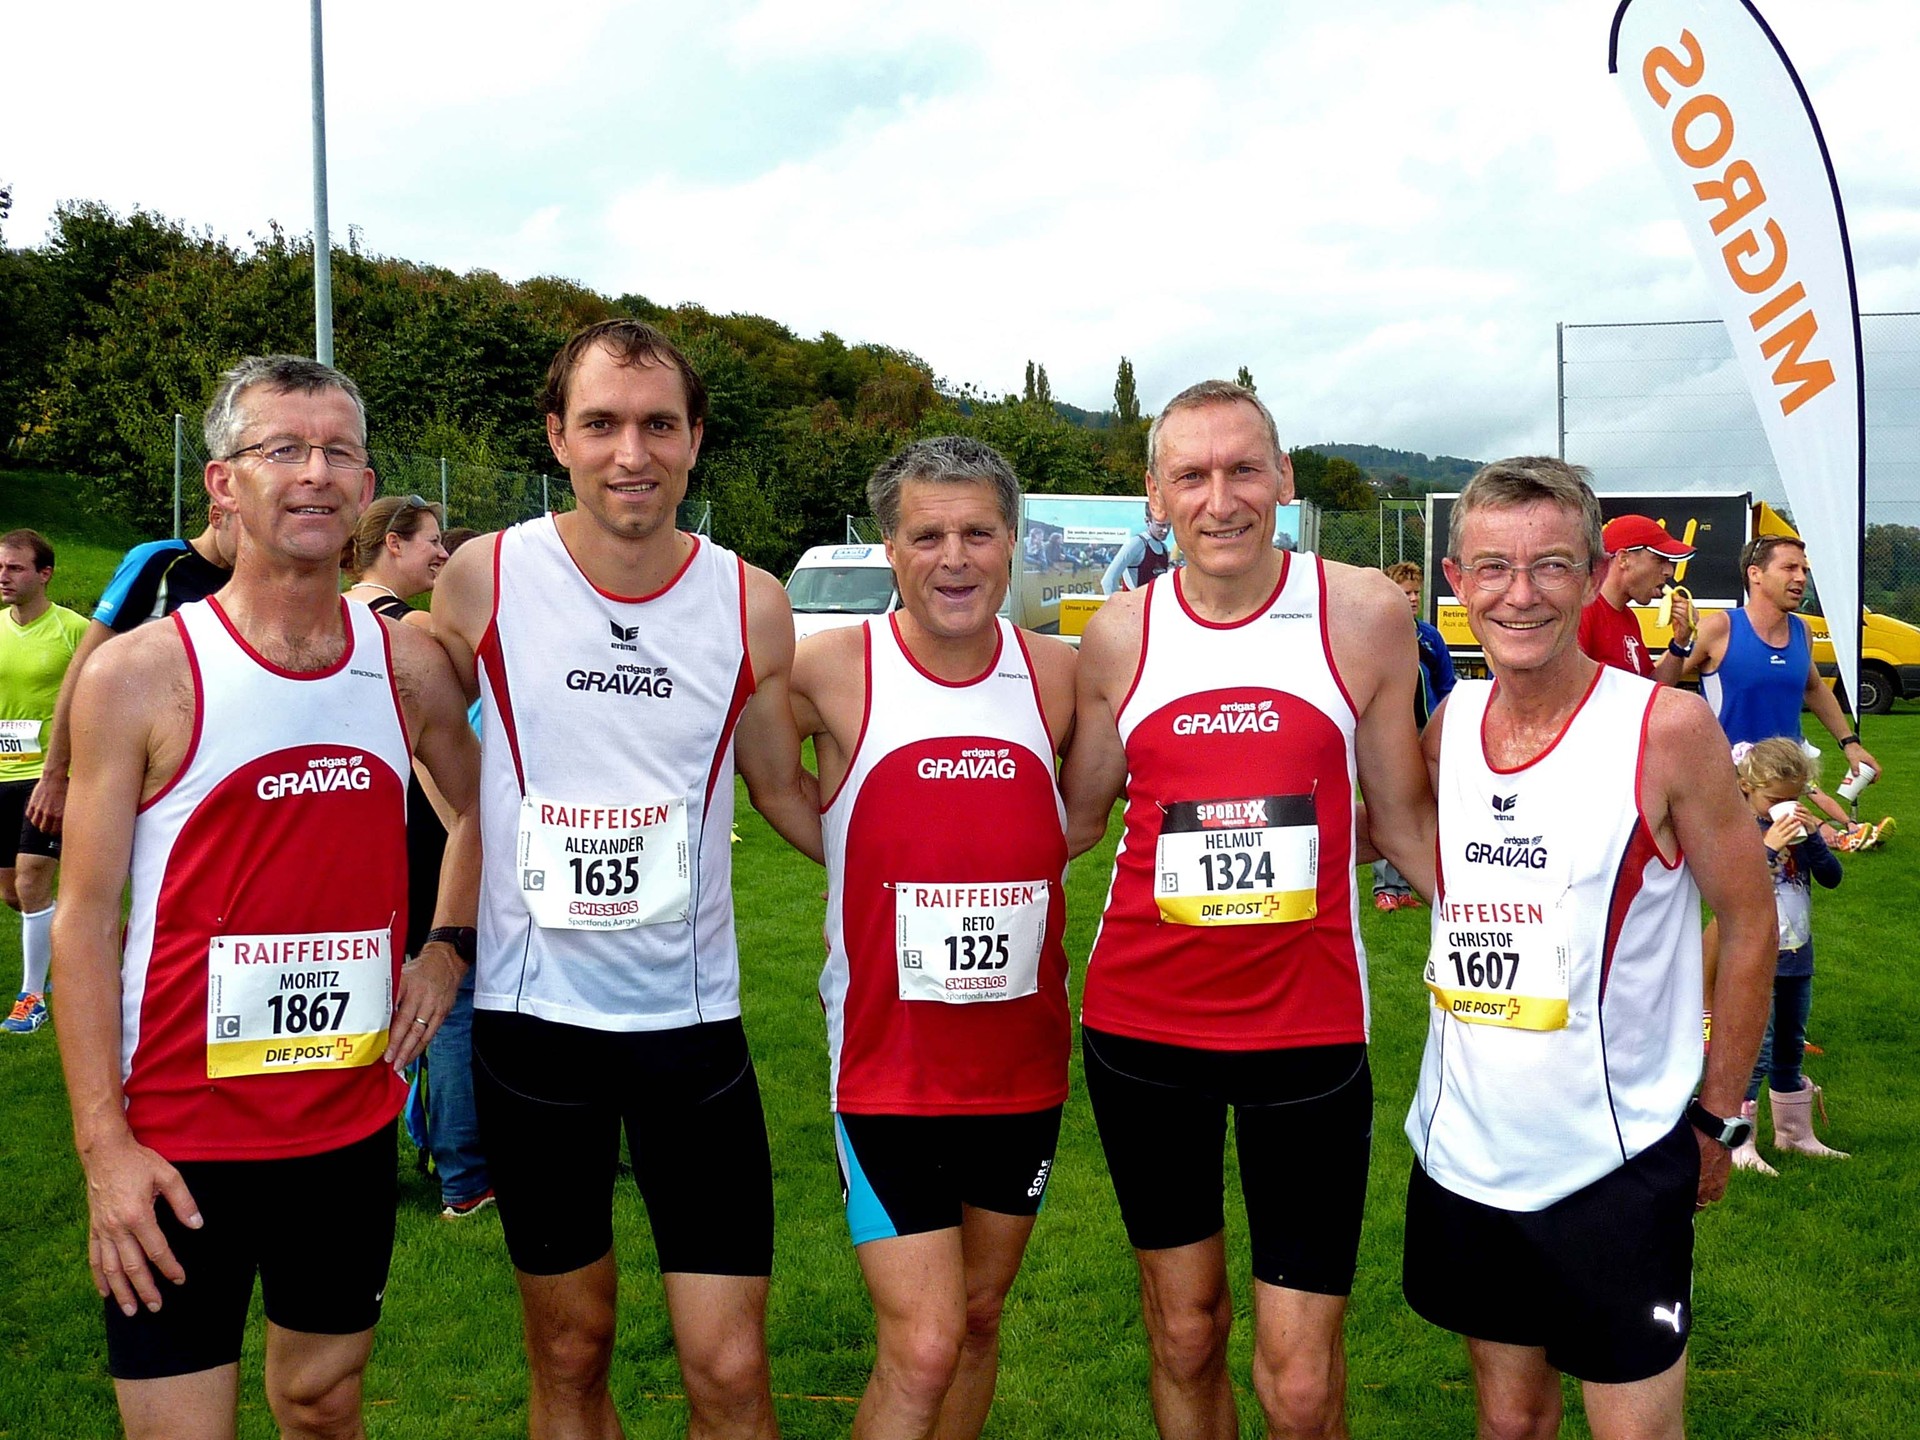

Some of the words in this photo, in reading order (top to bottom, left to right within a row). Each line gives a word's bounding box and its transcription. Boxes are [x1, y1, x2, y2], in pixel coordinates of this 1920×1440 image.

[1042, 585, 1064, 601] DIE
[1068, 581, 1092, 594] POST
[1811, 631, 1831, 639] POS
[611, 642, 637, 652] erima
[350, 669, 384, 680] BROOKS
[616, 664, 652, 674] erdgas
[566, 670, 674, 699] GRAVAG
[1220, 702, 1256, 713] erdgas
[1172, 711, 1280, 735] GRAVAG
[0, 739, 22, 752] 1501
[962, 748, 996, 758] erdgas
[308, 757, 348, 769] erdgas
[917, 758, 1016, 779] GRAVAG
[257, 767, 371, 800] GRAVAG
[541, 804, 669, 830] RAIFFEISEN
[565, 836, 644, 854] ALEXANDER
[1206, 832, 1264, 850] HELMUT
[1504, 836, 1530, 846] erdgas
[1465, 842, 1548, 869] GRAVAG
[569, 856, 640, 896] 1635
[1199, 851, 1276, 891] 1324
[529, 871, 544, 890] C
[1166, 874, 1177, 891] B
[916, 886, 1034, 908] RAIFFEISEN
[569, 900, 638, 916] SWISSLOS
[1202, 904, 1223, 916] DIE
[1226, 902, 1263, 915] POST
[568, 918, 612, 928] Sportfonds
[612, 918, 641, 928] Aargau
[962, 916, 995, 932] RETO
[1448, 932, 1514, 948] CHRISTOF
[234, 936, 380, 965] RAIFFEISEN
[944, 934, 1009, 970] 1325
[908, 952, 921, 968] B
[1448, 952, 1520, 990] 1607
[280, 971, 340, 990] MORITZ
[946, 976, 1007, 990] SWISSLOS
[946, 992, 984, 1000] Sportfonds
[985, 992, 1008, 1000] Aargau
[267, 992, 350, 1034] 1867
[1453, 1000, 1472, 1013] DIE
[1474, 1001, 1506, 1016] POST
[223, 1016, 238, 1036] C
[266, 1048, 292, 1063] DIE
[294, 1045, 334, 1062] POST
[1027, 1160, 1049, 1197] GORE
